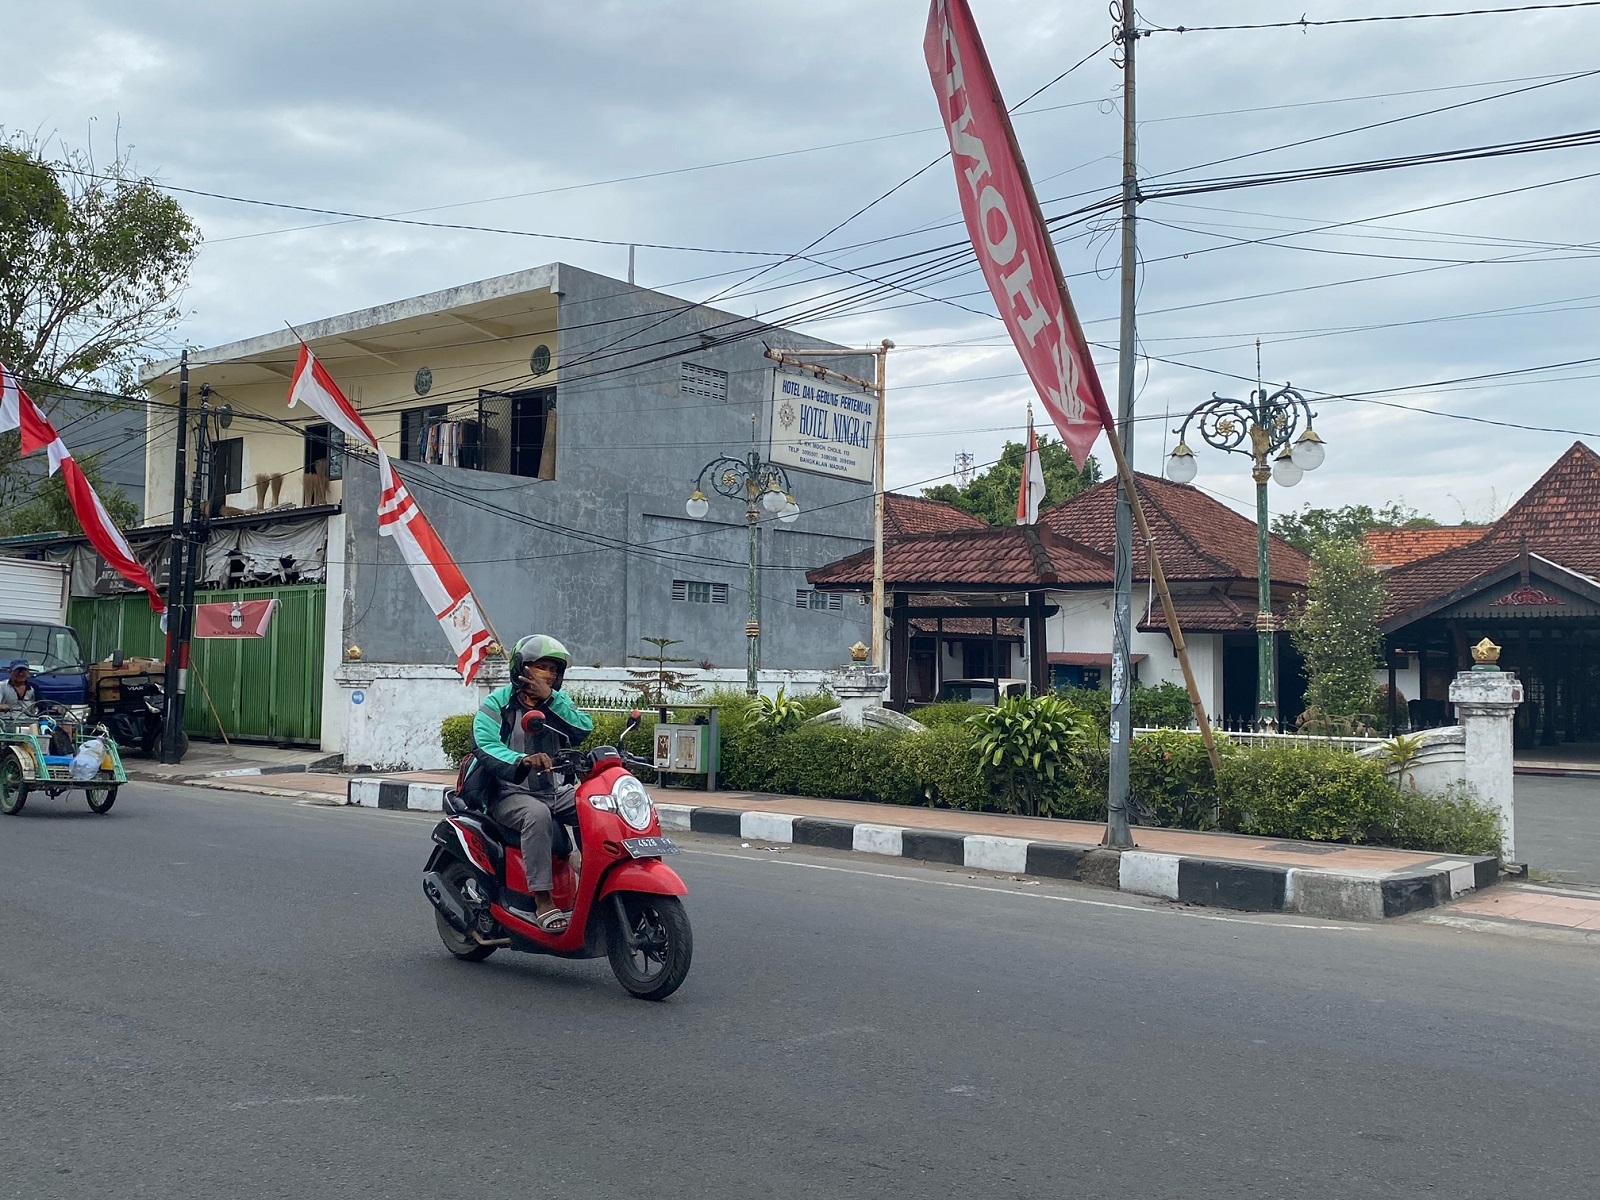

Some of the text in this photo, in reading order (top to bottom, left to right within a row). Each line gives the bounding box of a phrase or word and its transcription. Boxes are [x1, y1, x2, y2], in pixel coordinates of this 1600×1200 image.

[782, 380, 872, 416] HOTEL DAN GEDUNG PERTEMUAN
[799, 404, 829, 440] HOTEL
[832, 412, 872, 449] NINGRAT
[799, 456, 847, 472] BANGKALAN MADURA
[624, 841, 634, 849] L
